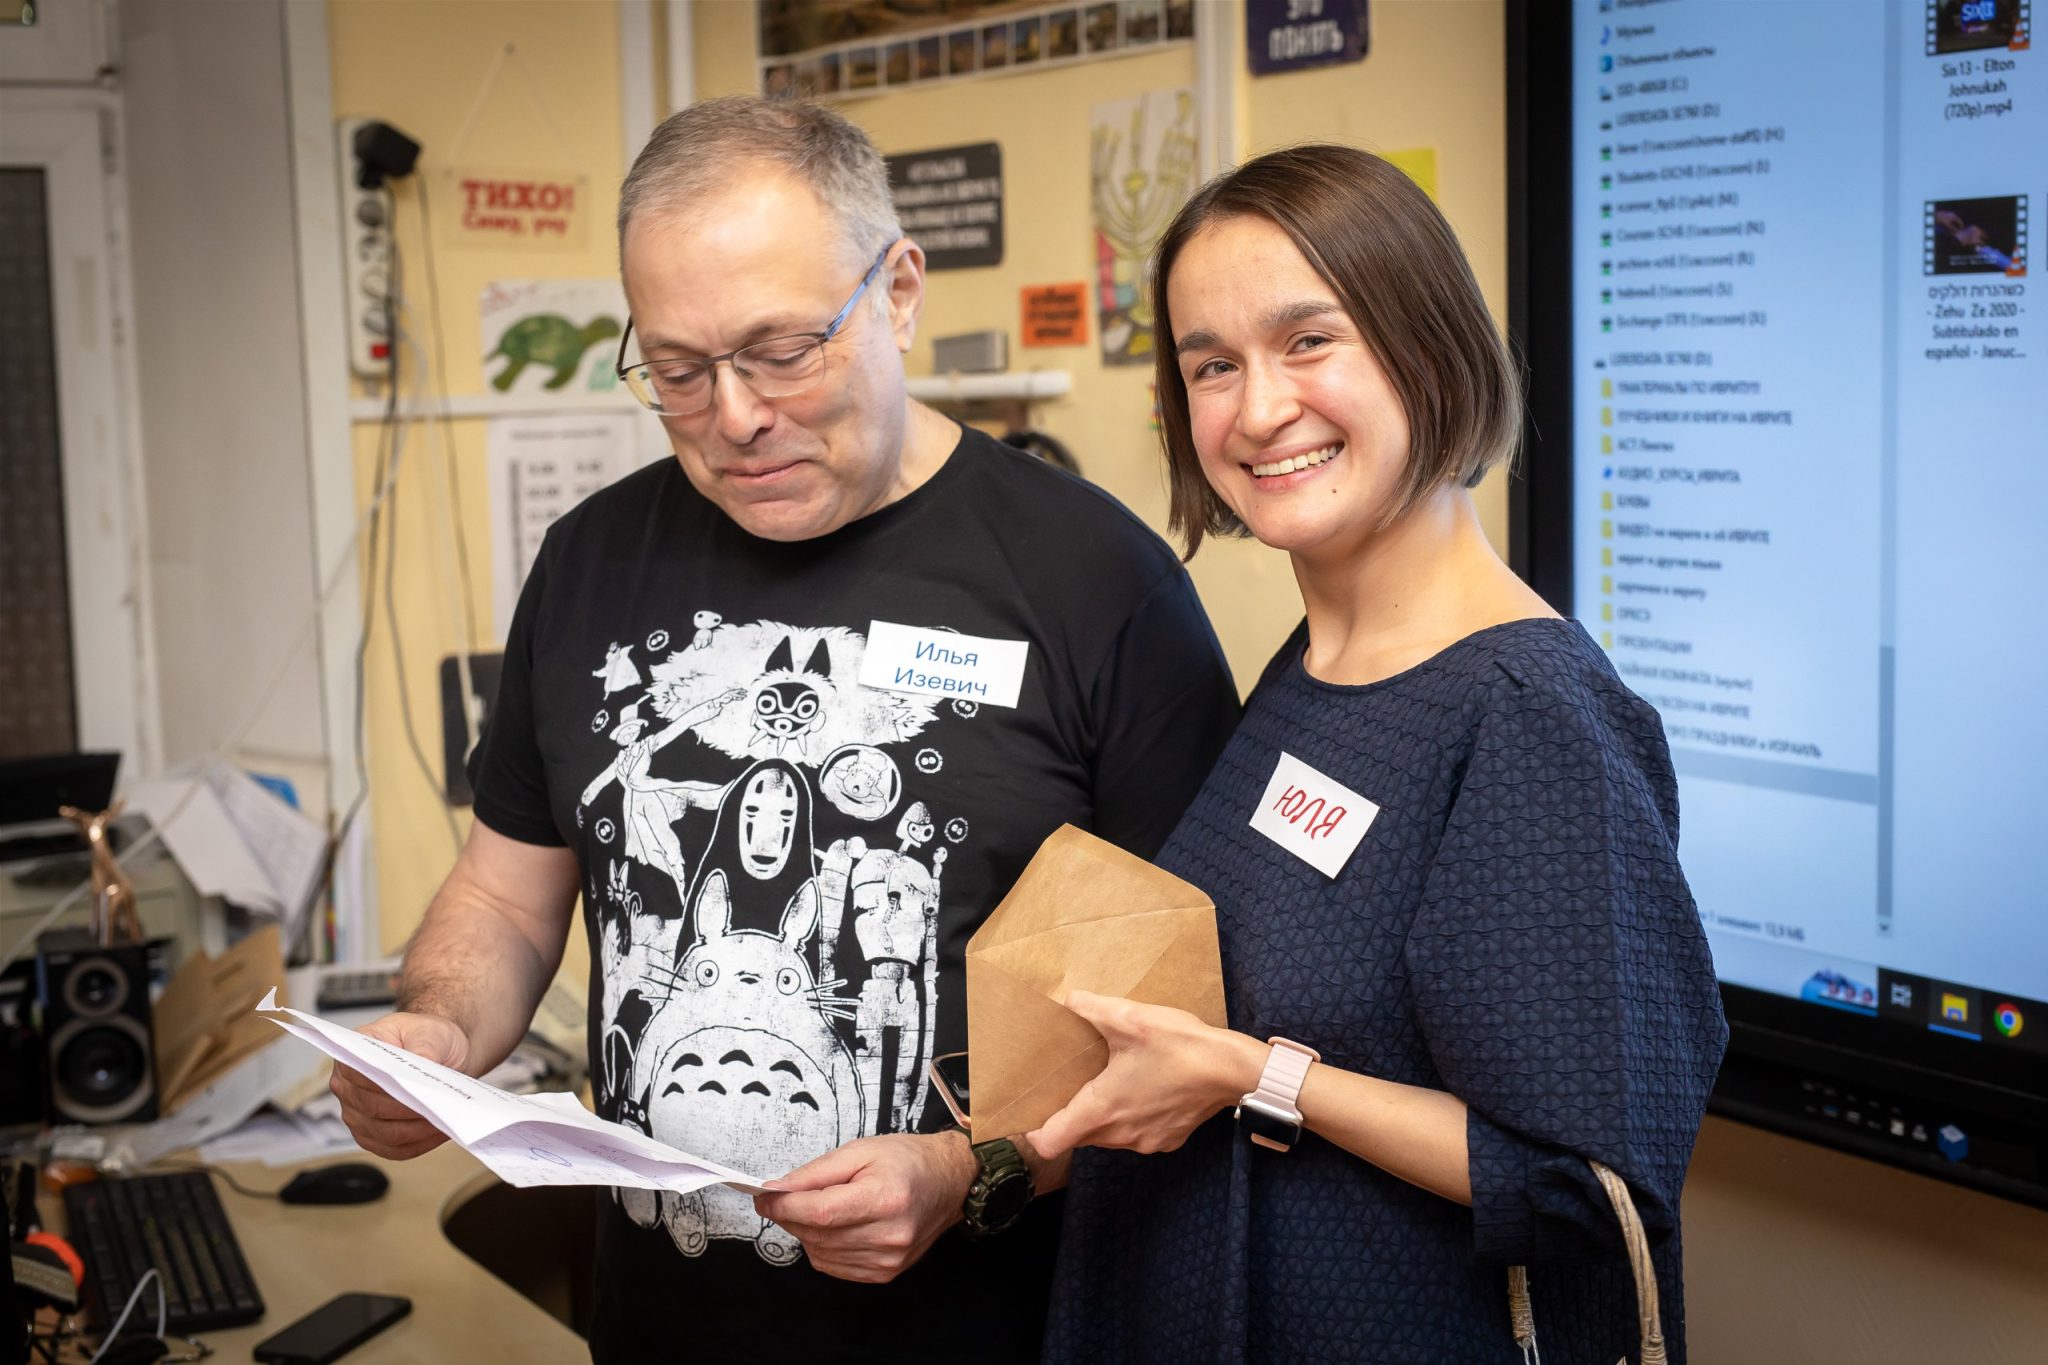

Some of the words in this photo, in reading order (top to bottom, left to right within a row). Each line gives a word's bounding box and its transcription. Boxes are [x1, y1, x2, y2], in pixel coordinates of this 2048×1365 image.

[1984, 58, 2016, 73] Elton
[1949, 79, 2007, 98] Johnukah
[460, 179, 574, 212] ТИХО!
[1935, 304, 1965, 318] Zehu
[1971, 302, 1986, 318] Ze
[1989, 302, 2018, 318] 2020
[1932, 324, 2000, 339] Subtitulado
[2004, 326, 2019, 338] en
[916, 641, 978, 667] Илья
[894, 667, 988, 696] Изевич
